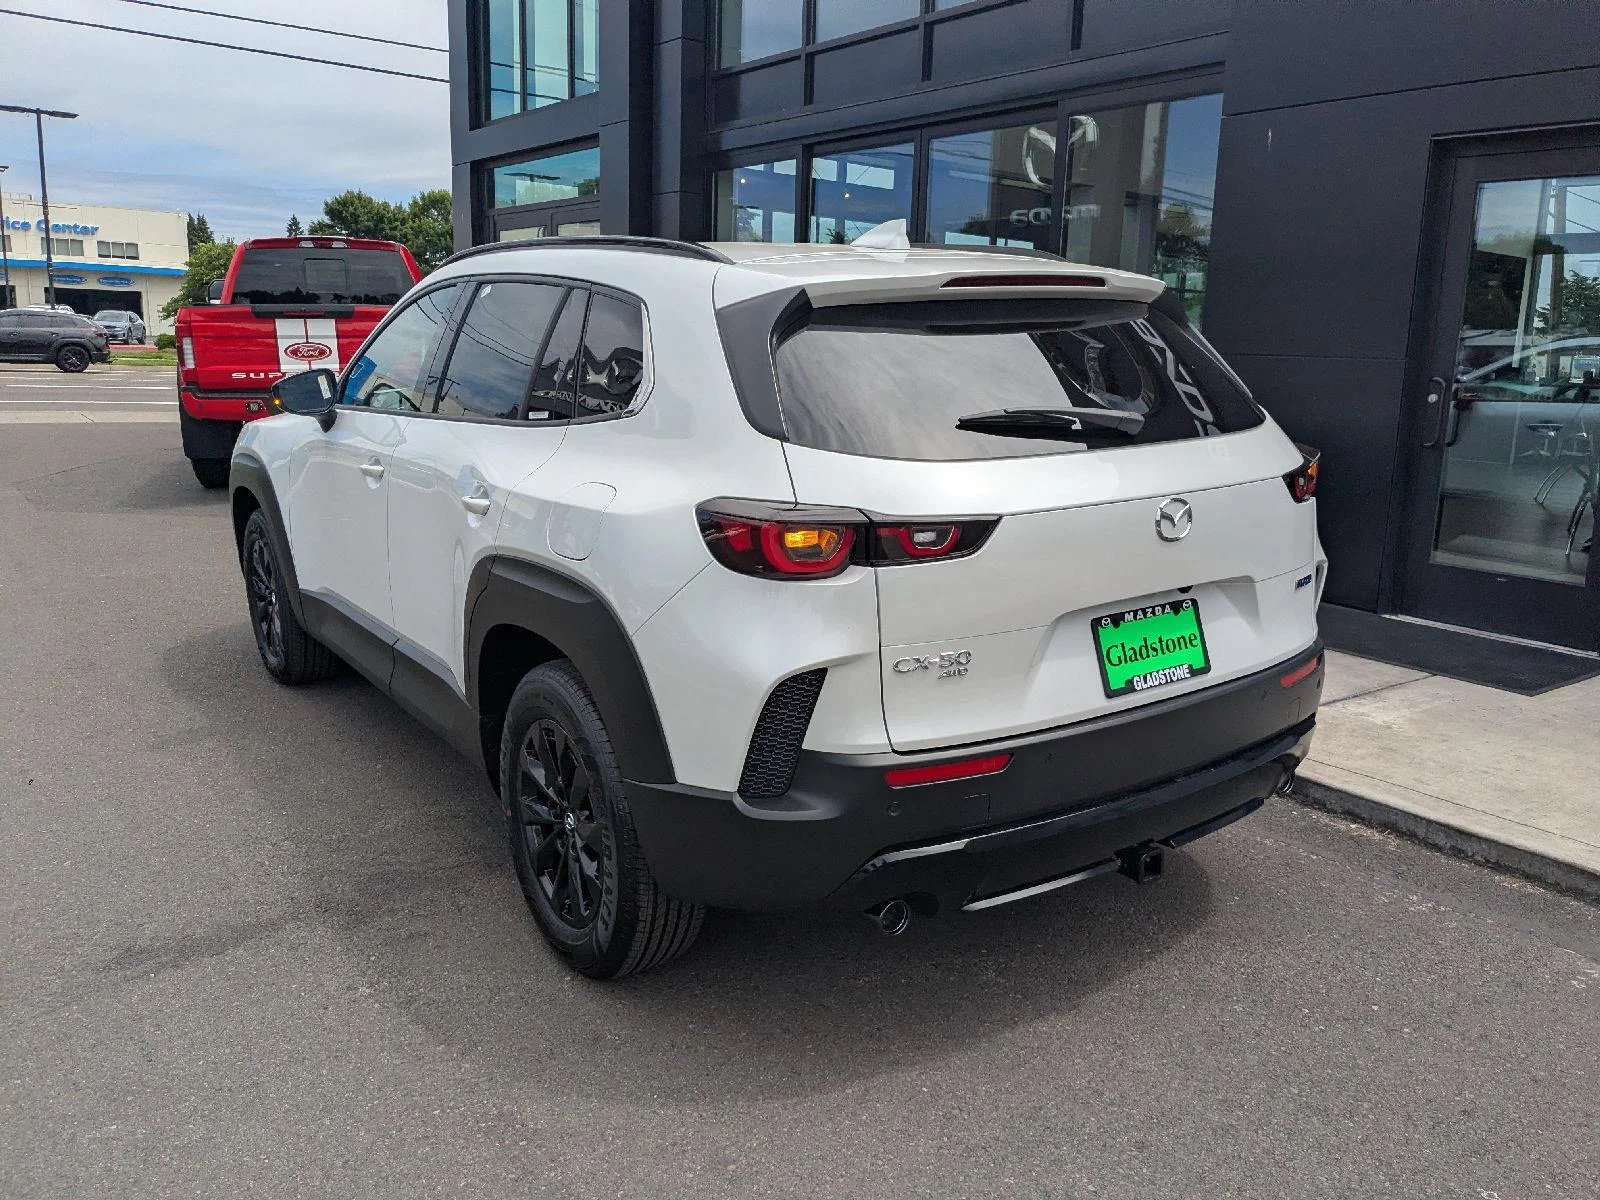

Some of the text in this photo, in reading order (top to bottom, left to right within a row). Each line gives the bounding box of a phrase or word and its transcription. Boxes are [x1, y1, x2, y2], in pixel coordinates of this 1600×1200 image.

[2, 215, 99, 236] ice Center
[1124, 604, 1171, 623] MAZDA
[892, 649, 972, 673] CX-50
[1105, 632, 1199, 667] Gladstone
[1133, 664, 1191, 690] GLADSTONE
